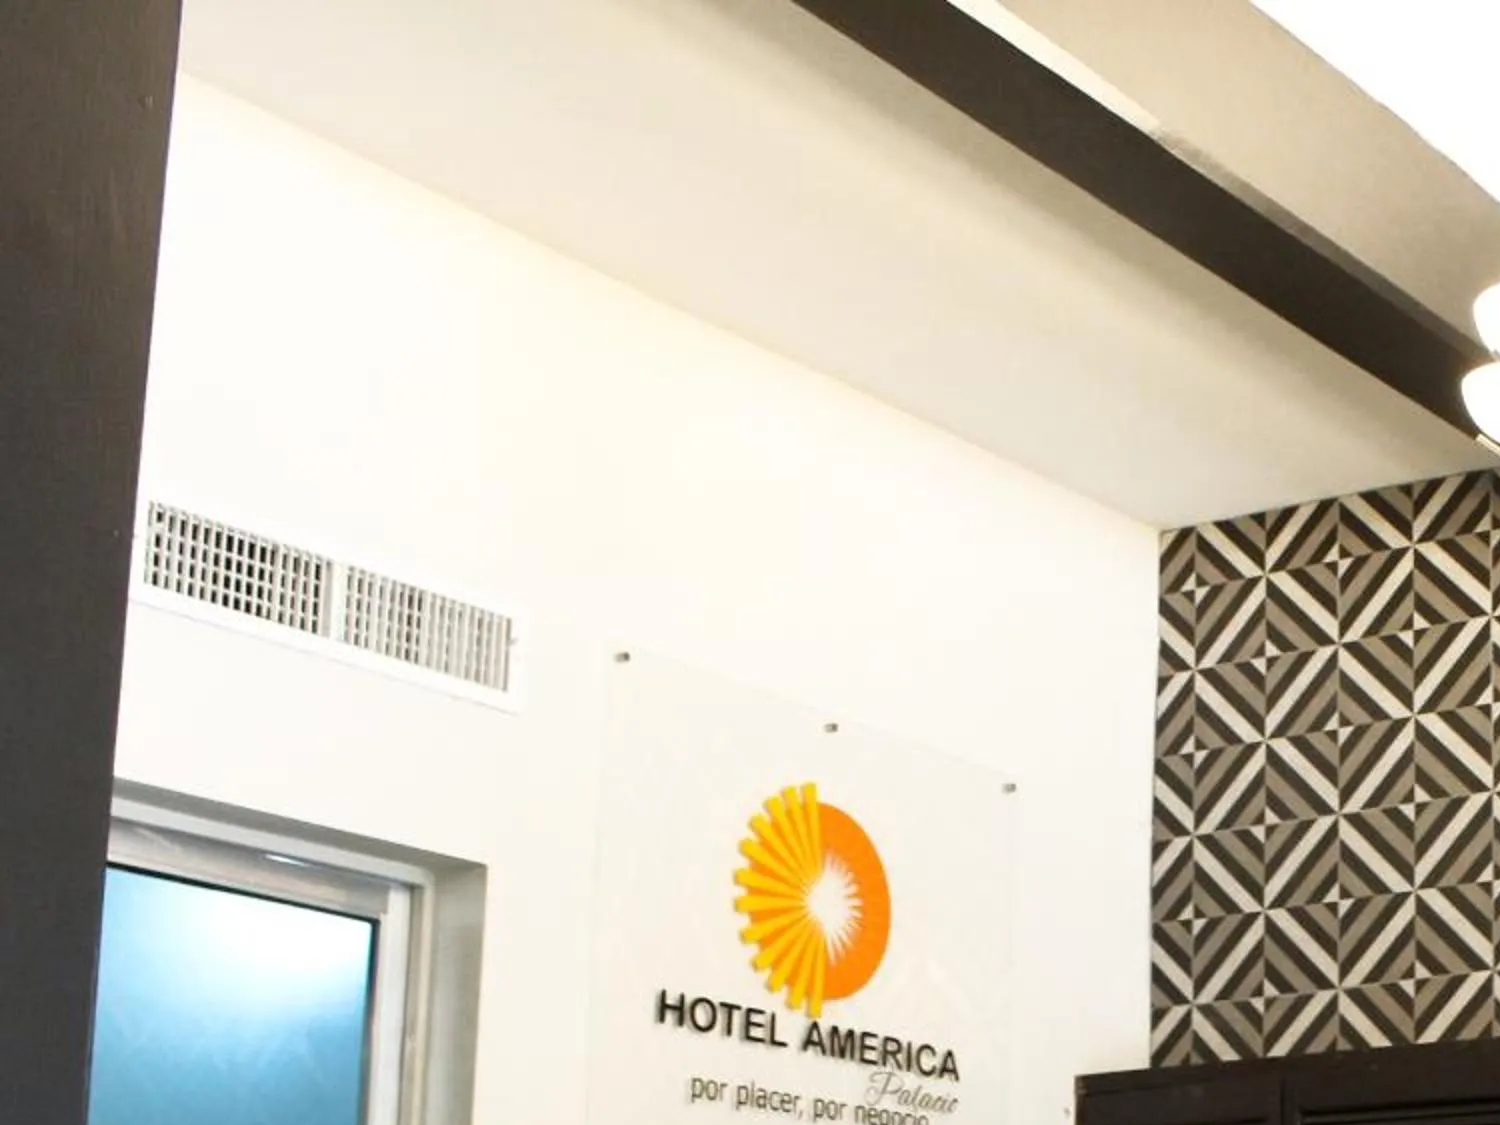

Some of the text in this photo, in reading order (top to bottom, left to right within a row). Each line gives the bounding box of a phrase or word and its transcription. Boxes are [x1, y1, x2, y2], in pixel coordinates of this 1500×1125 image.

[657, 989, 960, 1082] HOTEL AMERICA
[690, 1076, 727, 1103] por
[735, 1080, 803, 1118] placer,
[812, 1096, 848, 1123] por
